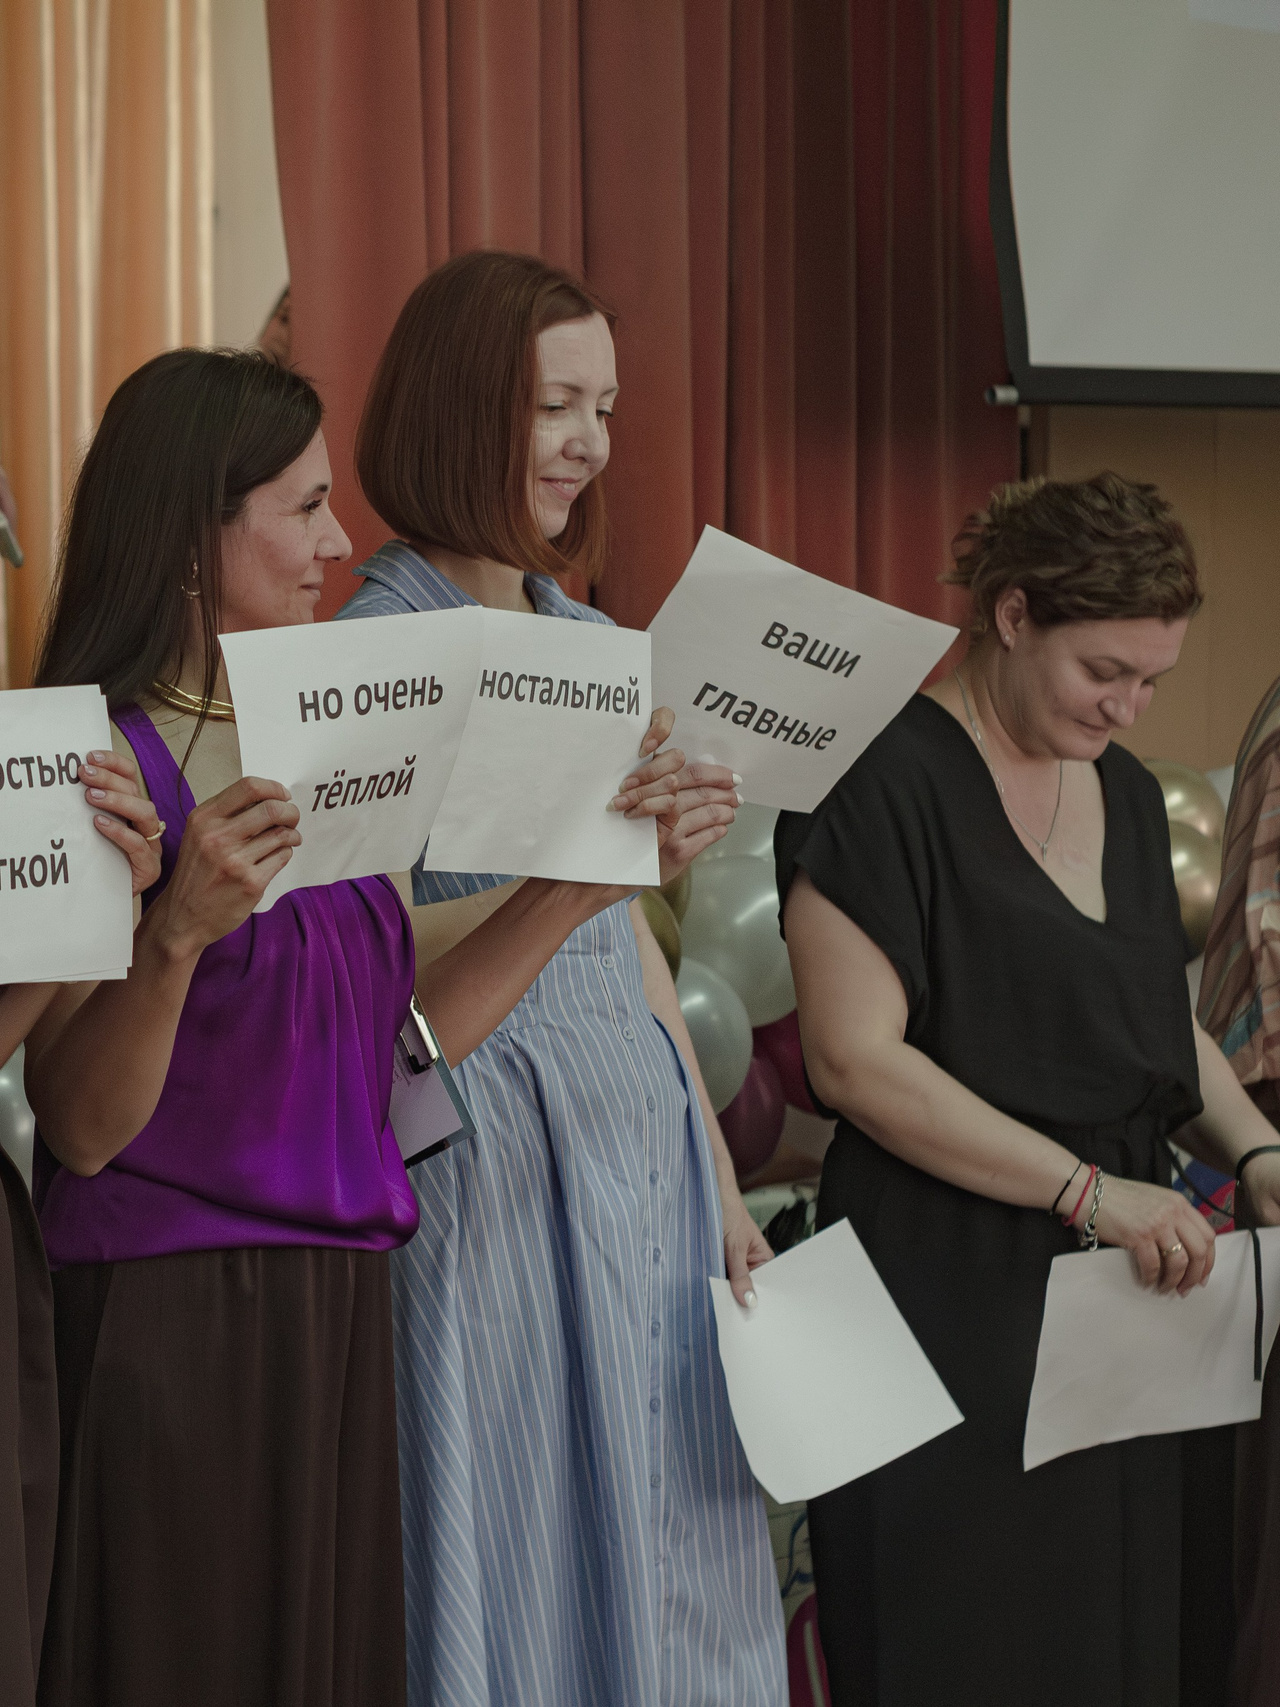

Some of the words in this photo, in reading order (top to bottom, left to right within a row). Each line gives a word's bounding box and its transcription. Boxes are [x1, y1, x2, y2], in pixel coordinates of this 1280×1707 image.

[760, 621, 862, 679] ваши
[298, 687, 345, 723] но
[353, 675, 444, 716] очень
[478, 668, 641, 716] ностальгией
[692, 681, 838, 751] главные
[311, 754, 417, 813] тёплой
